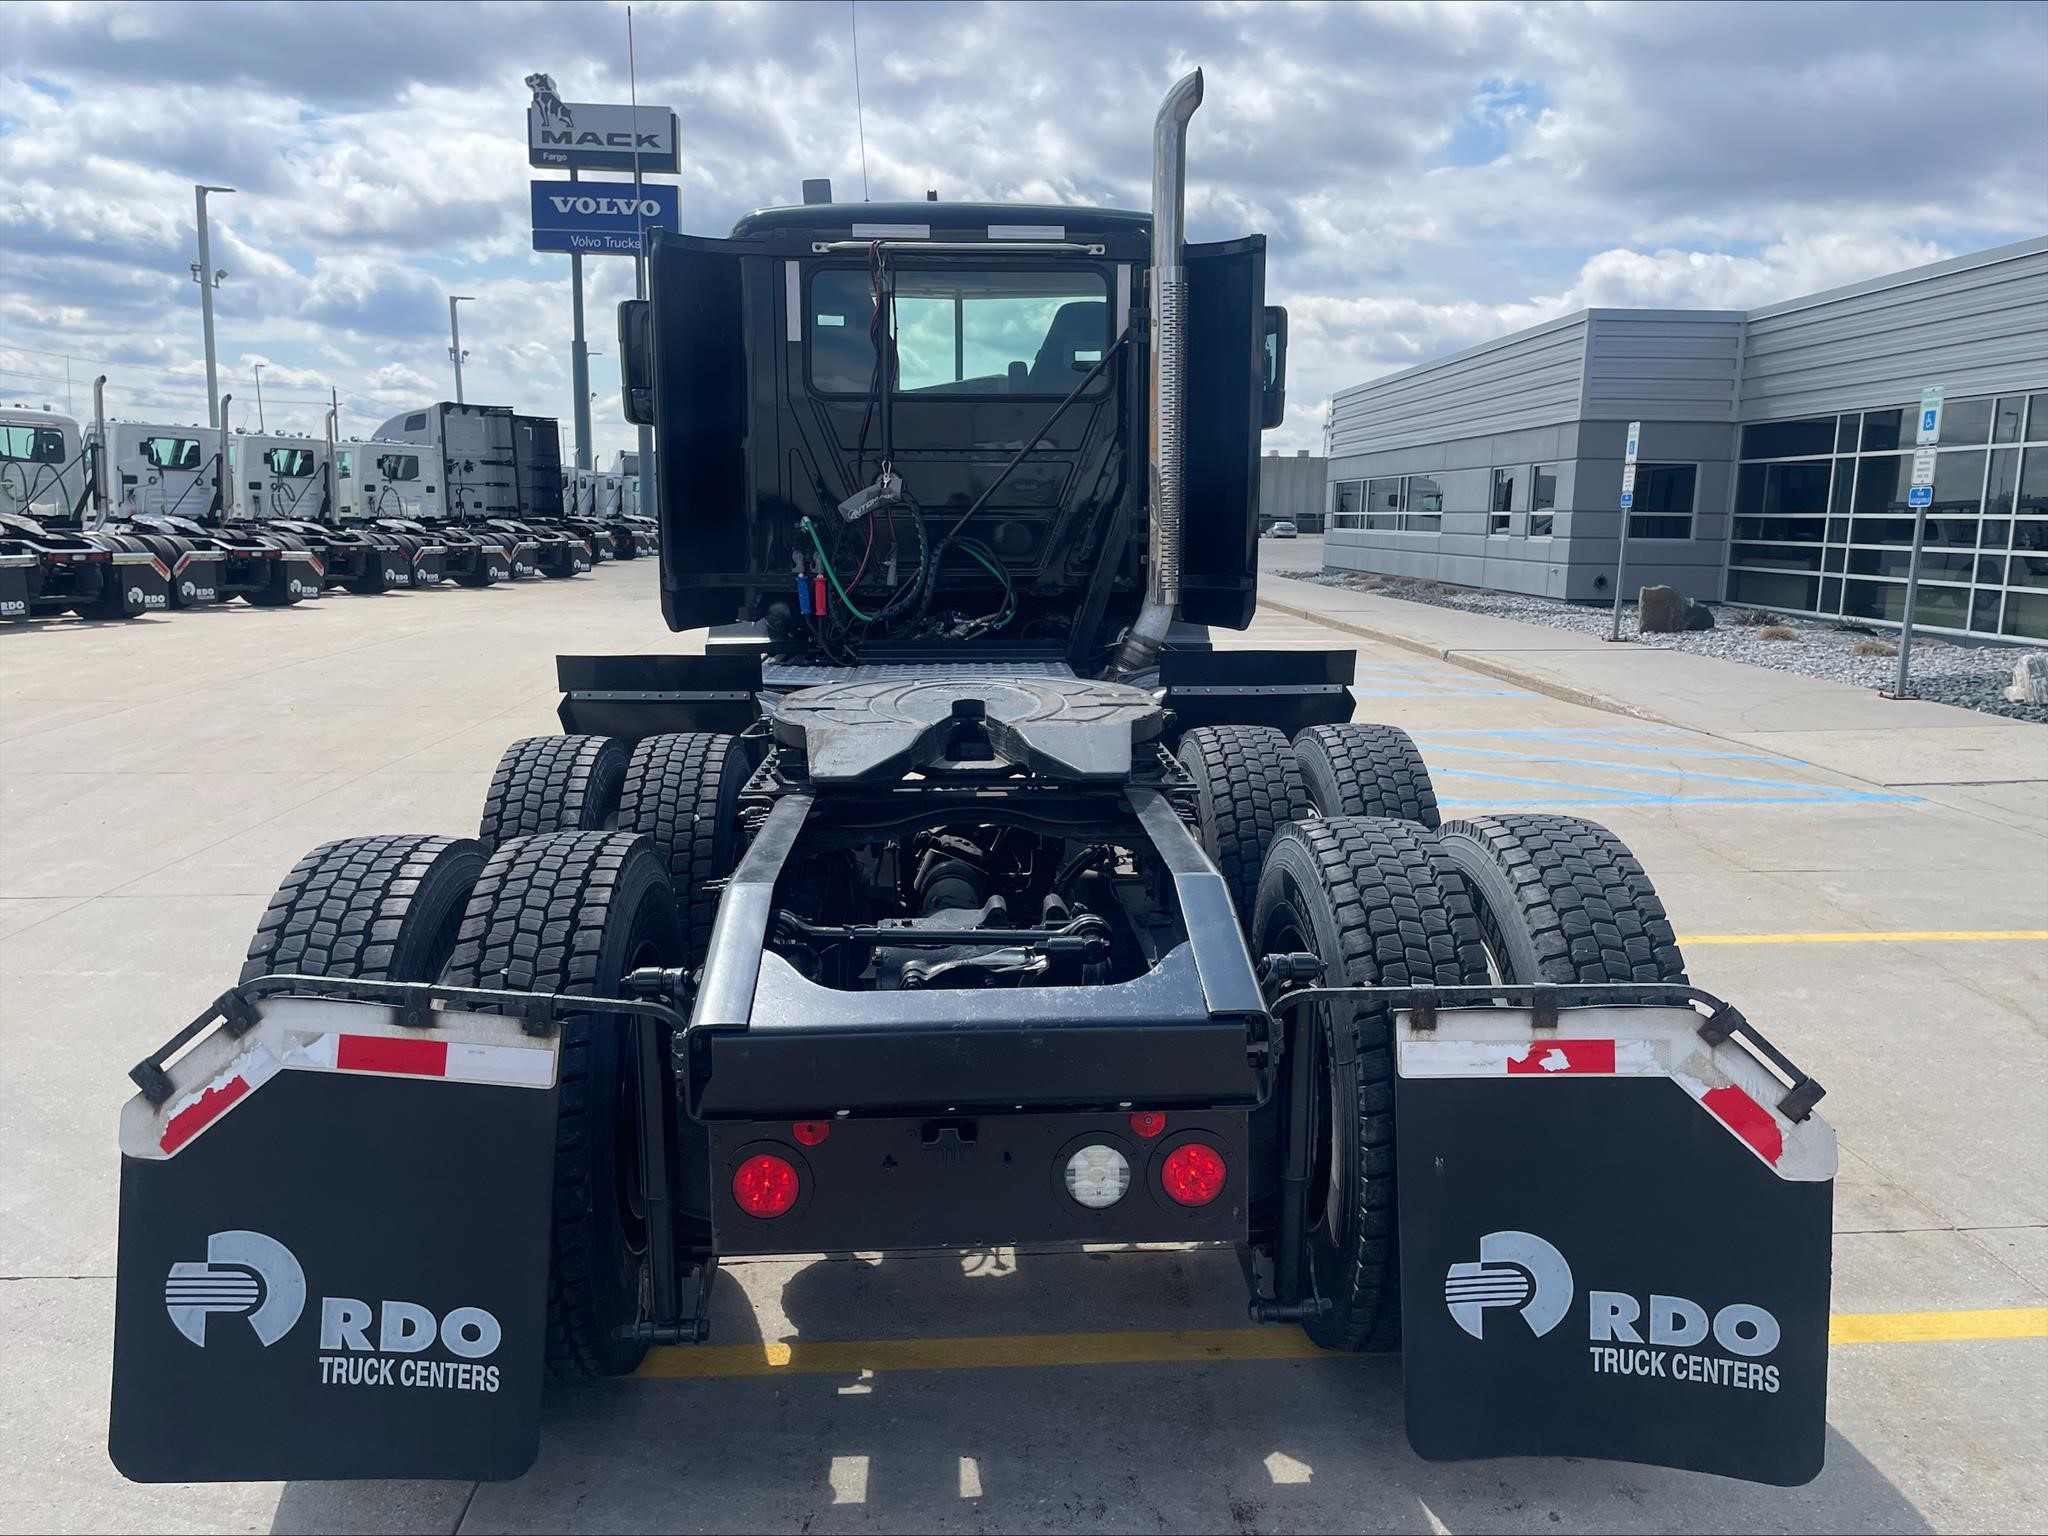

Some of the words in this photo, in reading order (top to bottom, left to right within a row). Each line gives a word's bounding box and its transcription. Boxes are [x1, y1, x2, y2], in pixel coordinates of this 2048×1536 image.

[541, 130, 661, 149] MACK
[543, 152, 567, 162] Fargo
[549, 196, 661, 217] VOLVO
[571, 235, 601, 248] Volvo
[604, 236, 641, 249] Trucks
[1, 600, 25, 611] RDO
[144, 595, 166, 603] RDO
[319, 1296, 502, 1359] RDO
[1589, 1290, 1782, 1358] RDO
[318, 1356, 395, 1386] TRUCK
[400, 1358, 501, 1393] CENTERS
[1589, 1346, 1667, 1378] TRUCK
[1671, 1352, 1781, 1394] CENTERS
